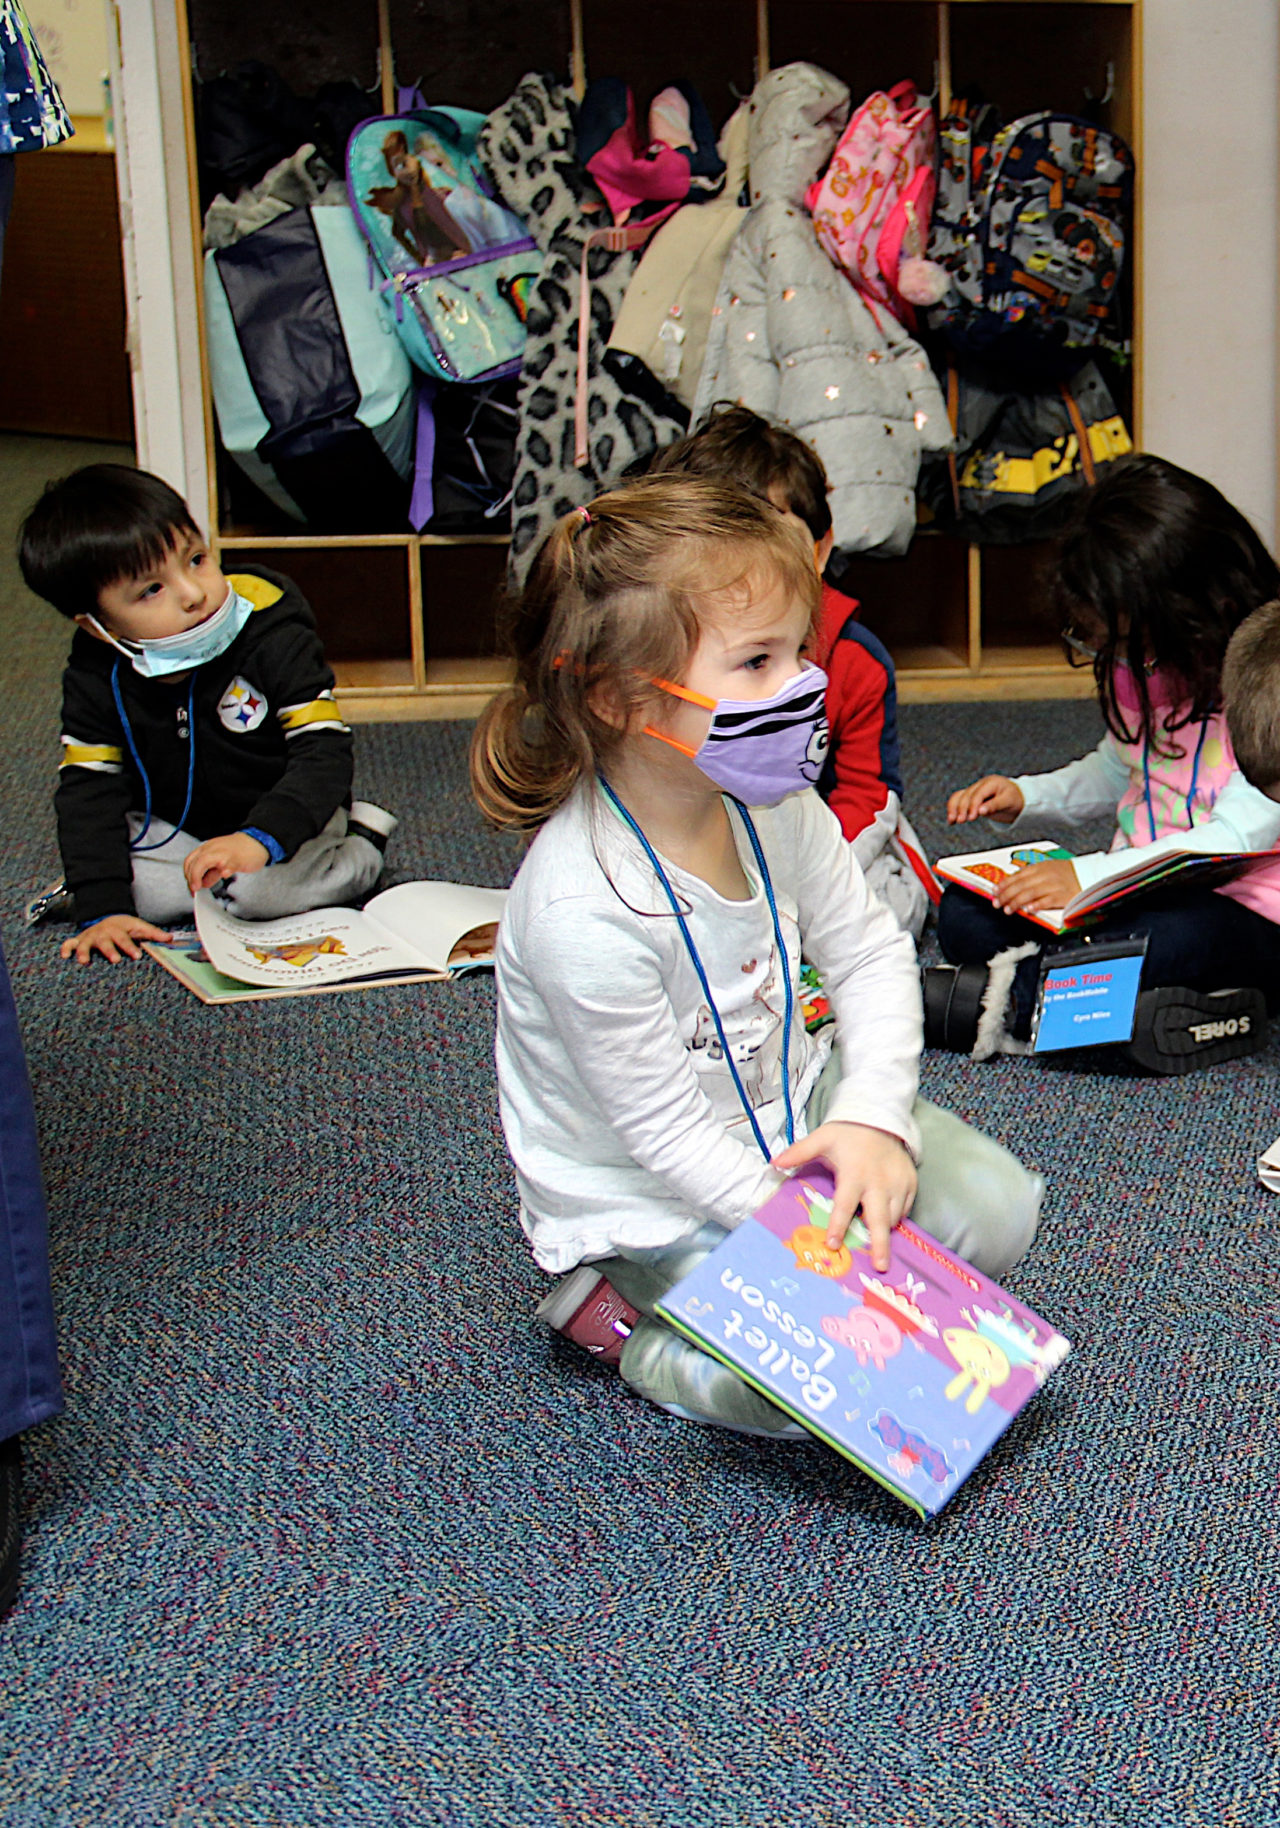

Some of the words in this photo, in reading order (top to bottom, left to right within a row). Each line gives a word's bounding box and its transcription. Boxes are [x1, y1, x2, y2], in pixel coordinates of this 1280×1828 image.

[1044, 977, 1078, 991] Book
[1082, 973, 1113, 985] Time
[1188, 1016, 1251, 1043] SOREL
[720, 1267, 836, 1373] Lesson
[722, 1308, 838, 1412] Ballet
